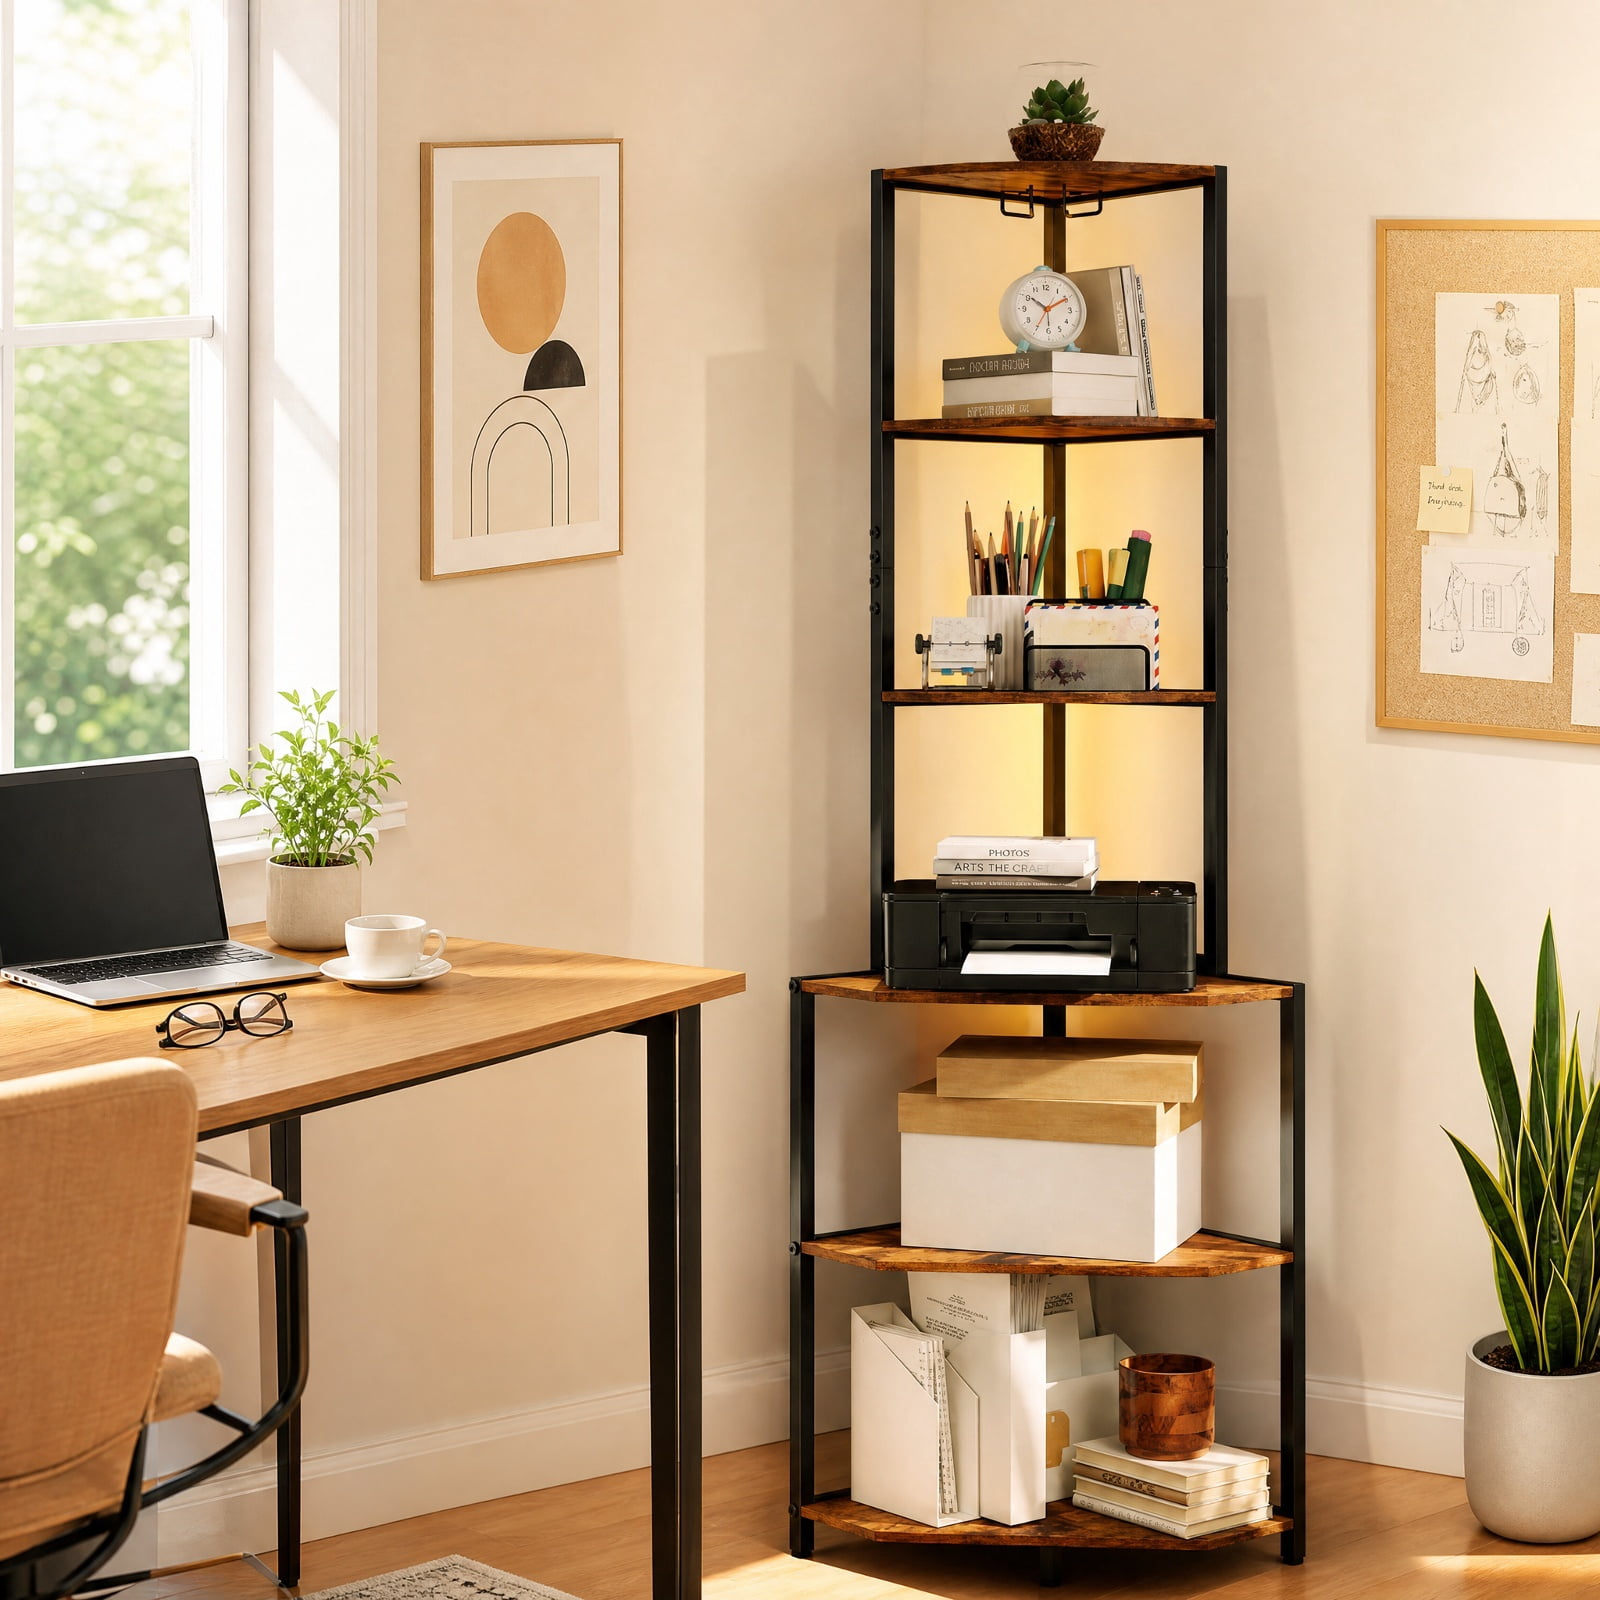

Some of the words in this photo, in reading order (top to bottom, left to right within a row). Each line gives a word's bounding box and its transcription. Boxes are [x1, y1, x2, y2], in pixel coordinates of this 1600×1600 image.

[1042, 284, 1050, 292] 12
[988, 849, 1030, 857] PHOTOS
[954, 862, 984, 872] ARTS
[988, 863, 1010, 873] THE
